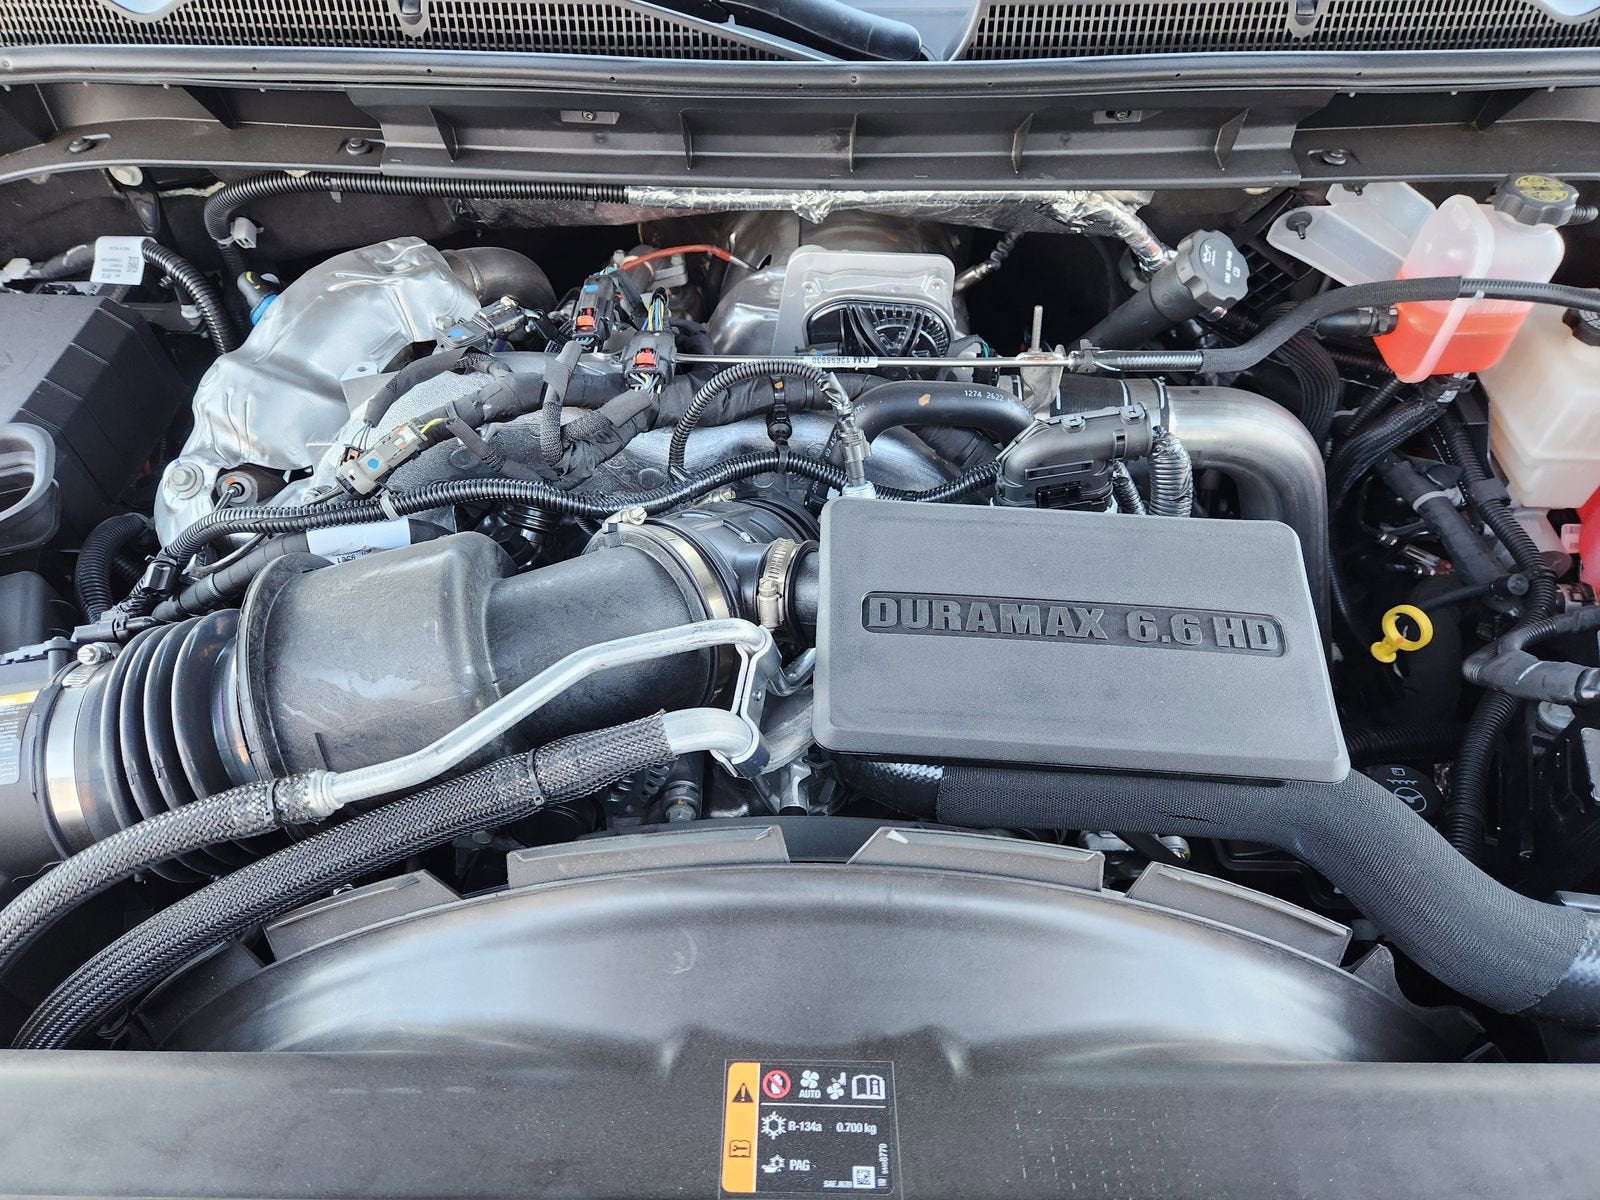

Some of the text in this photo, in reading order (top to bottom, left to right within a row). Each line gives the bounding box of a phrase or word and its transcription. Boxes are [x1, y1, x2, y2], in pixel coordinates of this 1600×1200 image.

[964, 389, 1005, 401] 1274 2622
[867, 596, 1279, 652] DURAMAX 6.6 HD
[799, 1089, 821, 1099] AUTO
[788, 1120, 878, 1135] R-134a 0.700 kg
[789, 1159, 811, 1171] PAG
